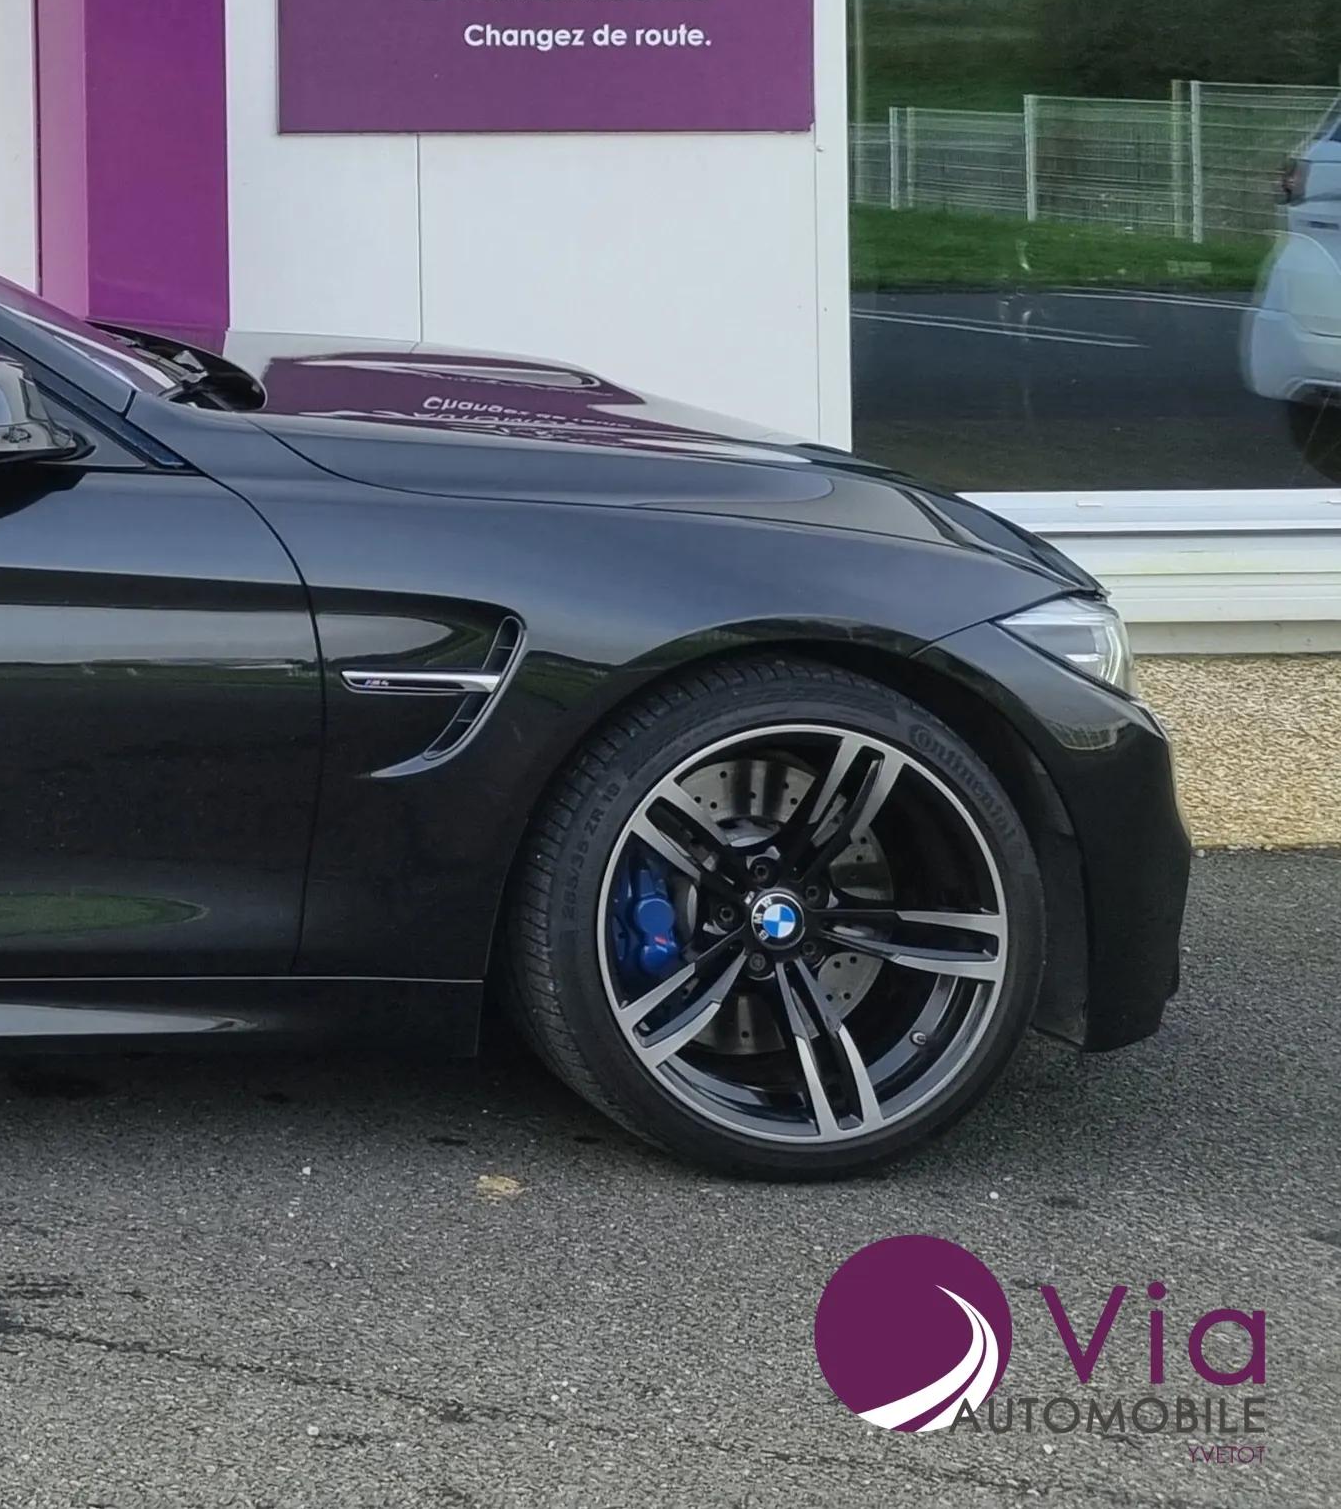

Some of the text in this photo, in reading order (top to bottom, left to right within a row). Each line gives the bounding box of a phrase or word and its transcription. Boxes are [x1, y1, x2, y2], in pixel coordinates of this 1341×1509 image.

[464, 24, 712, 51] Changez de route.
[584, 807, 605, 836] ZR
